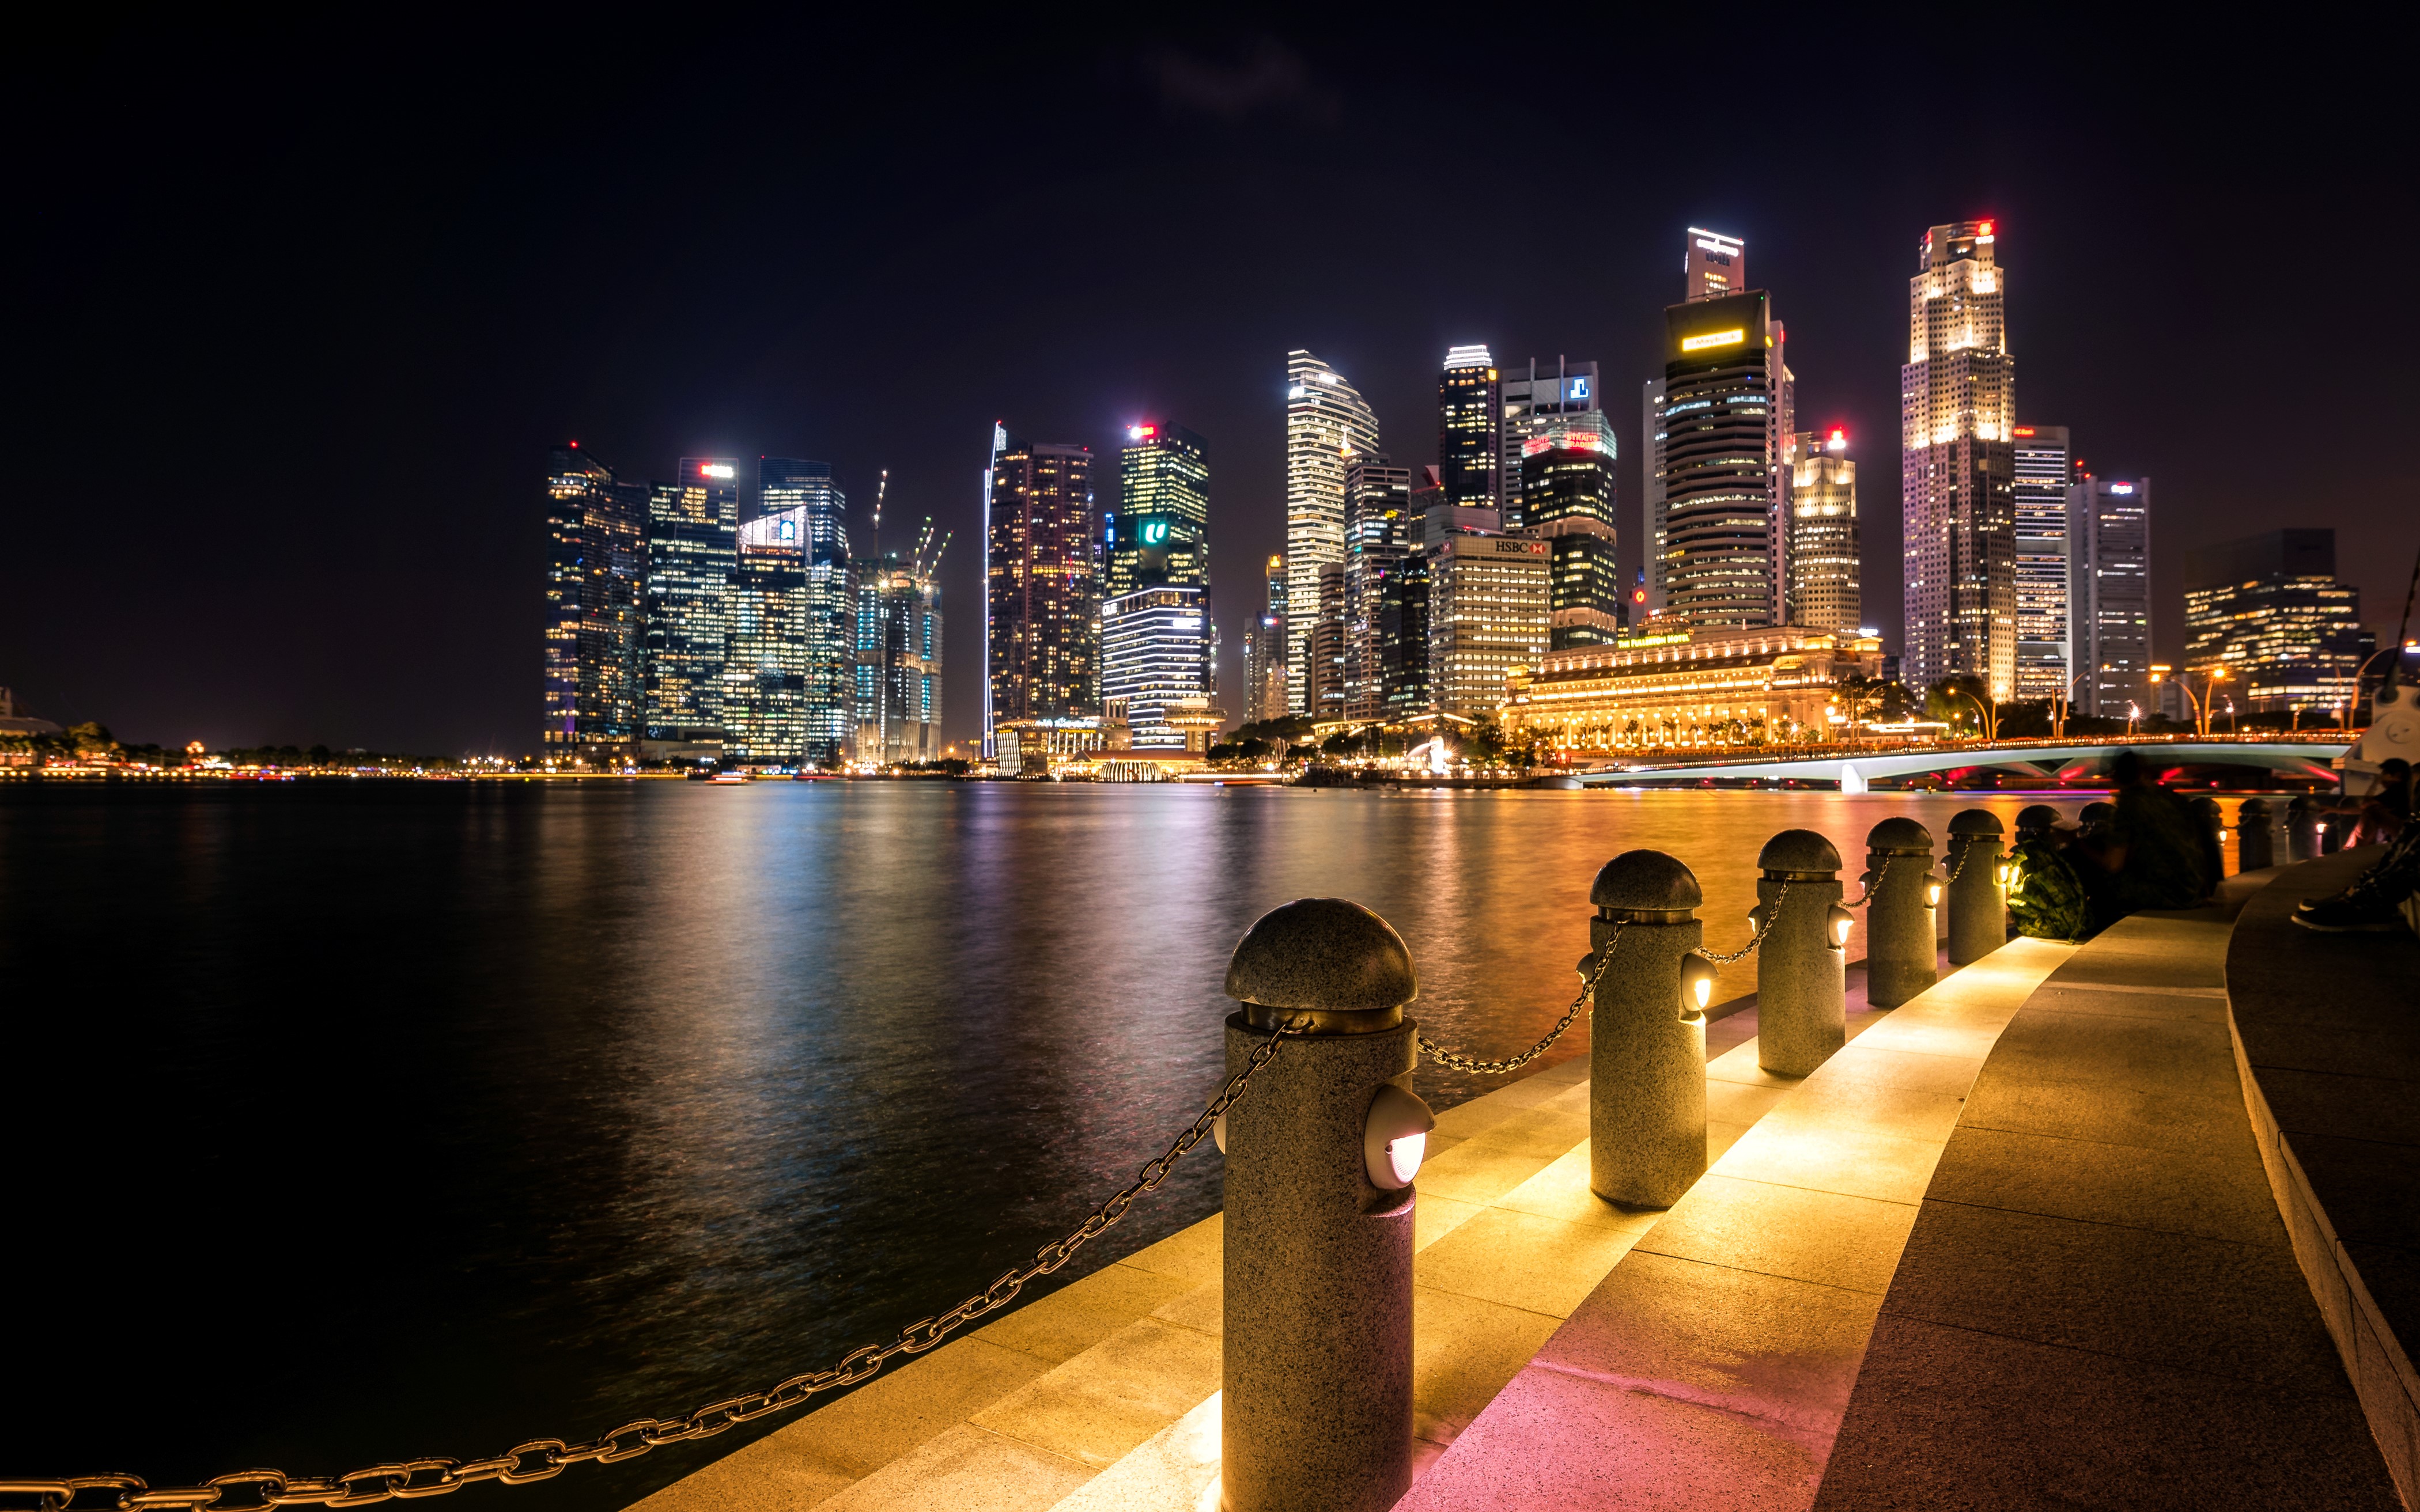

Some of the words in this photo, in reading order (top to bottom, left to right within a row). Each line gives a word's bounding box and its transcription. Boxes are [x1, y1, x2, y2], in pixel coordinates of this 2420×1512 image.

[1566, 440, 1599, 449] TRADIN
[1567, 434, 1598, 442] STRAITS
[1495, 541, 1528, 554] HSBC
[1102, 602, 1118, 616] OUE
[1631, 636, 1666, 647] FULLERTON
[1667, 634, 1690, 643] HOTEL
